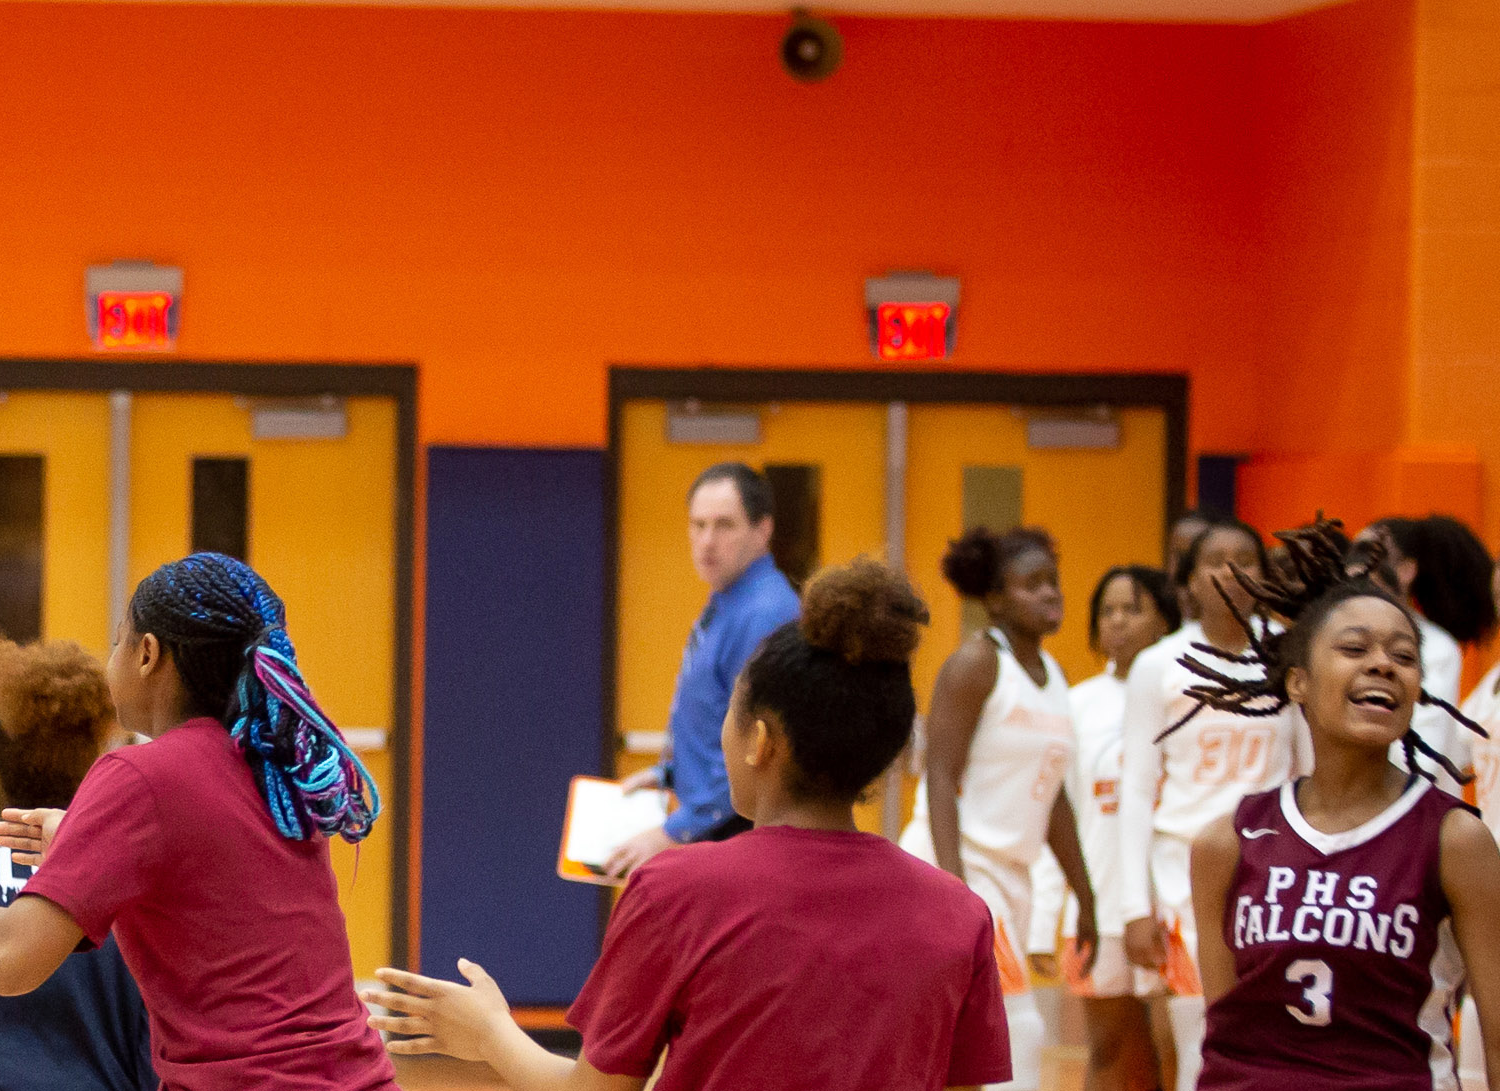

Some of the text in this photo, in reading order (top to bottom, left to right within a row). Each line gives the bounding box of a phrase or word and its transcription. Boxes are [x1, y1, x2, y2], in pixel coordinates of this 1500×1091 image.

[1264, 865, 1378, 910] PHS
[1234, 895, 1419, 959] FALCONS
[1285, 959, 1333, 1027] 3
